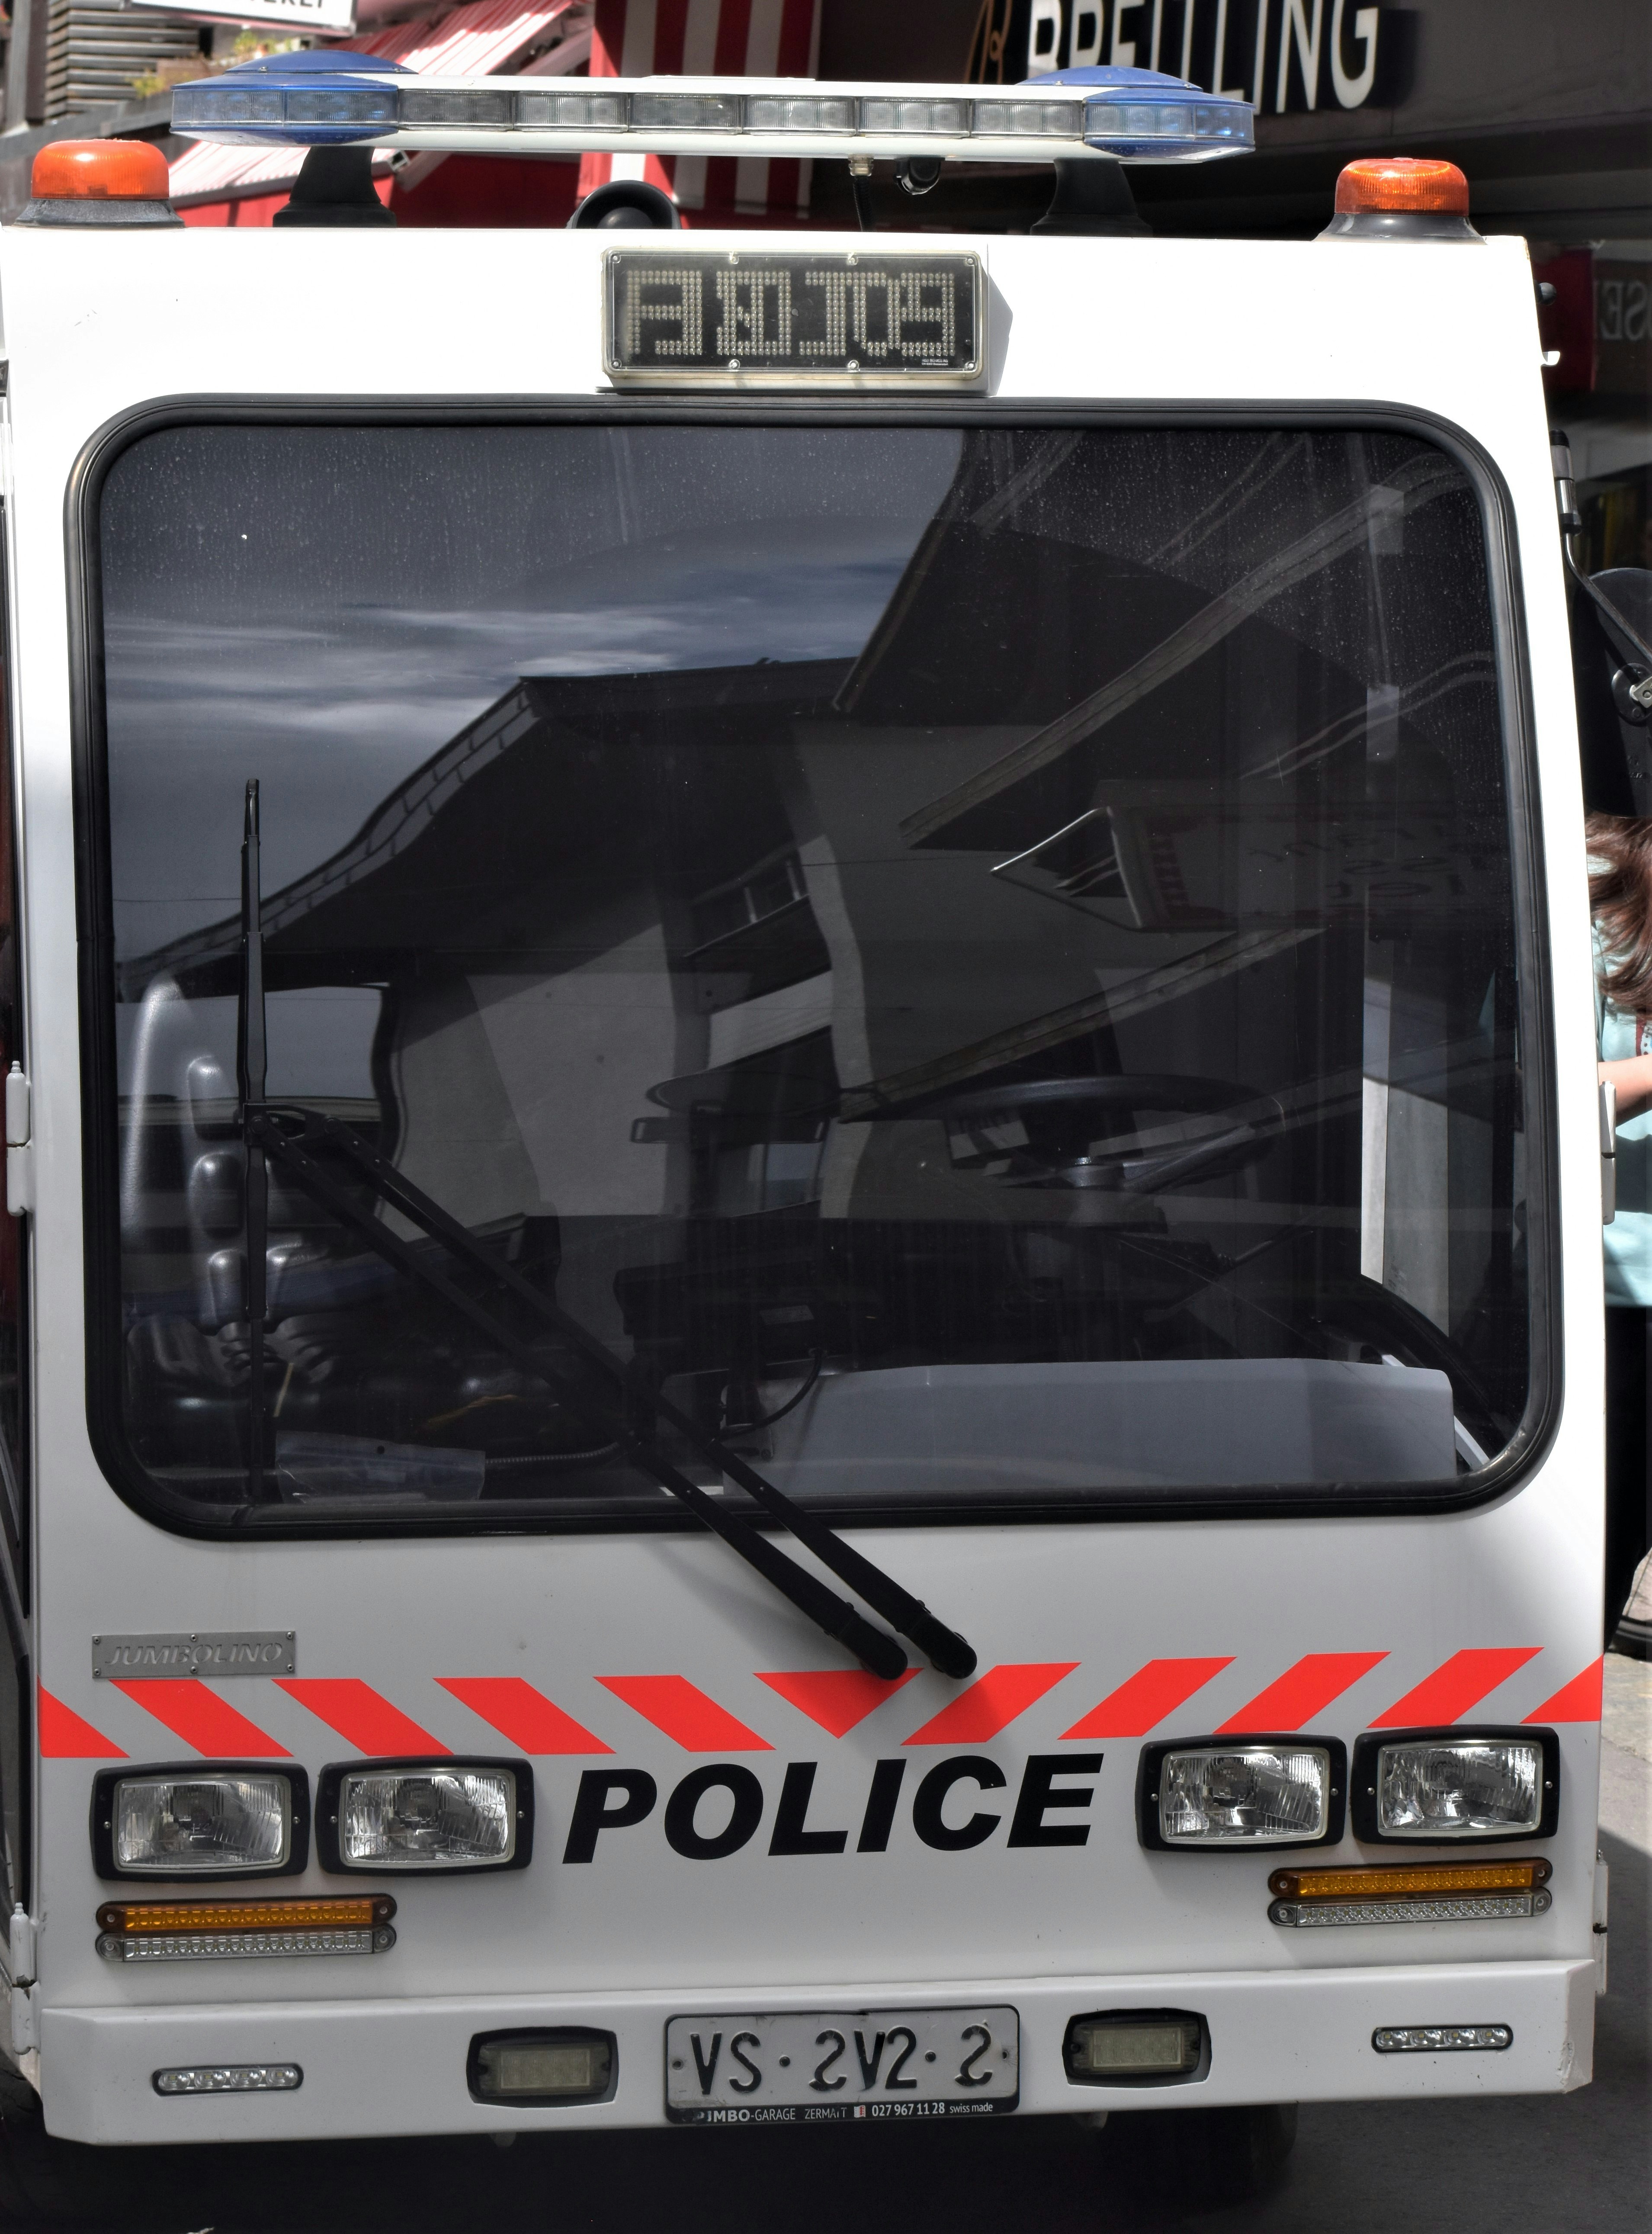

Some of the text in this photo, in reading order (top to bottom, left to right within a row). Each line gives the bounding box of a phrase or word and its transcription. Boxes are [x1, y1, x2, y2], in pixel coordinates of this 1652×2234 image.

[105, 1643, 282, 1665] JUMBOLINO
[562, 1752, 1104, 1864] POLICE
[695, 2108, 796, 2122] MBO-GARAGE
[872, 2104, 892, 2117] 027
[895, 2103, 914, 2115] 967
[917, 2103, 930, 2115] 11
[932, 2102, 945, 2114] 28
[949, 2103, 971, 2113] swiss
[972, 2102, 993, 2112] made
